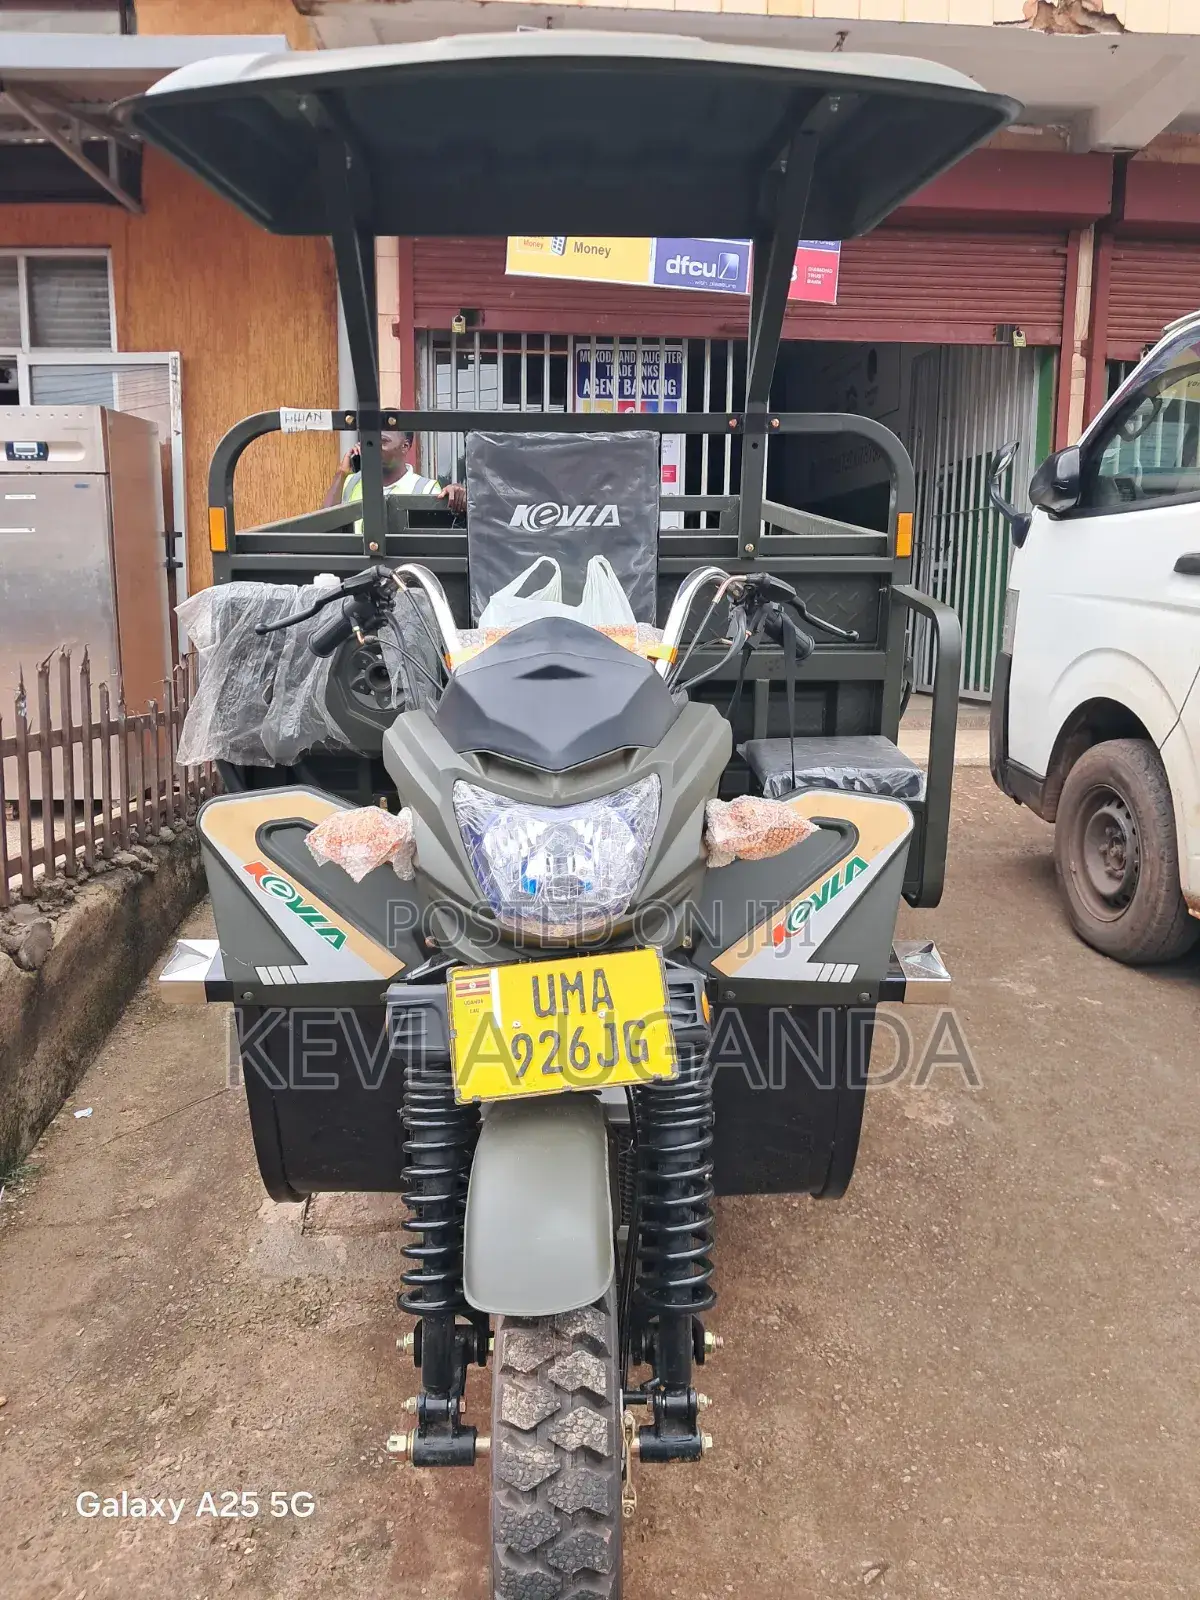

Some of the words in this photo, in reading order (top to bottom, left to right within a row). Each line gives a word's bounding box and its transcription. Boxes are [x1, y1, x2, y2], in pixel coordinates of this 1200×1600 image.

[523, 239, 544, 249] Money
[573, 242, 611, 258] Money
[665, 255, 716, 278] dfcu
[618, 351, 636, 363] AND
[640, 352, 682, 364] AUGTER
[634, 365, 659, 377] LNKS
[582, 378, 620, 395] AGEN
[531, 968, 615, 1018] UMA
[510, 1019, 649, 1078] 926JG
